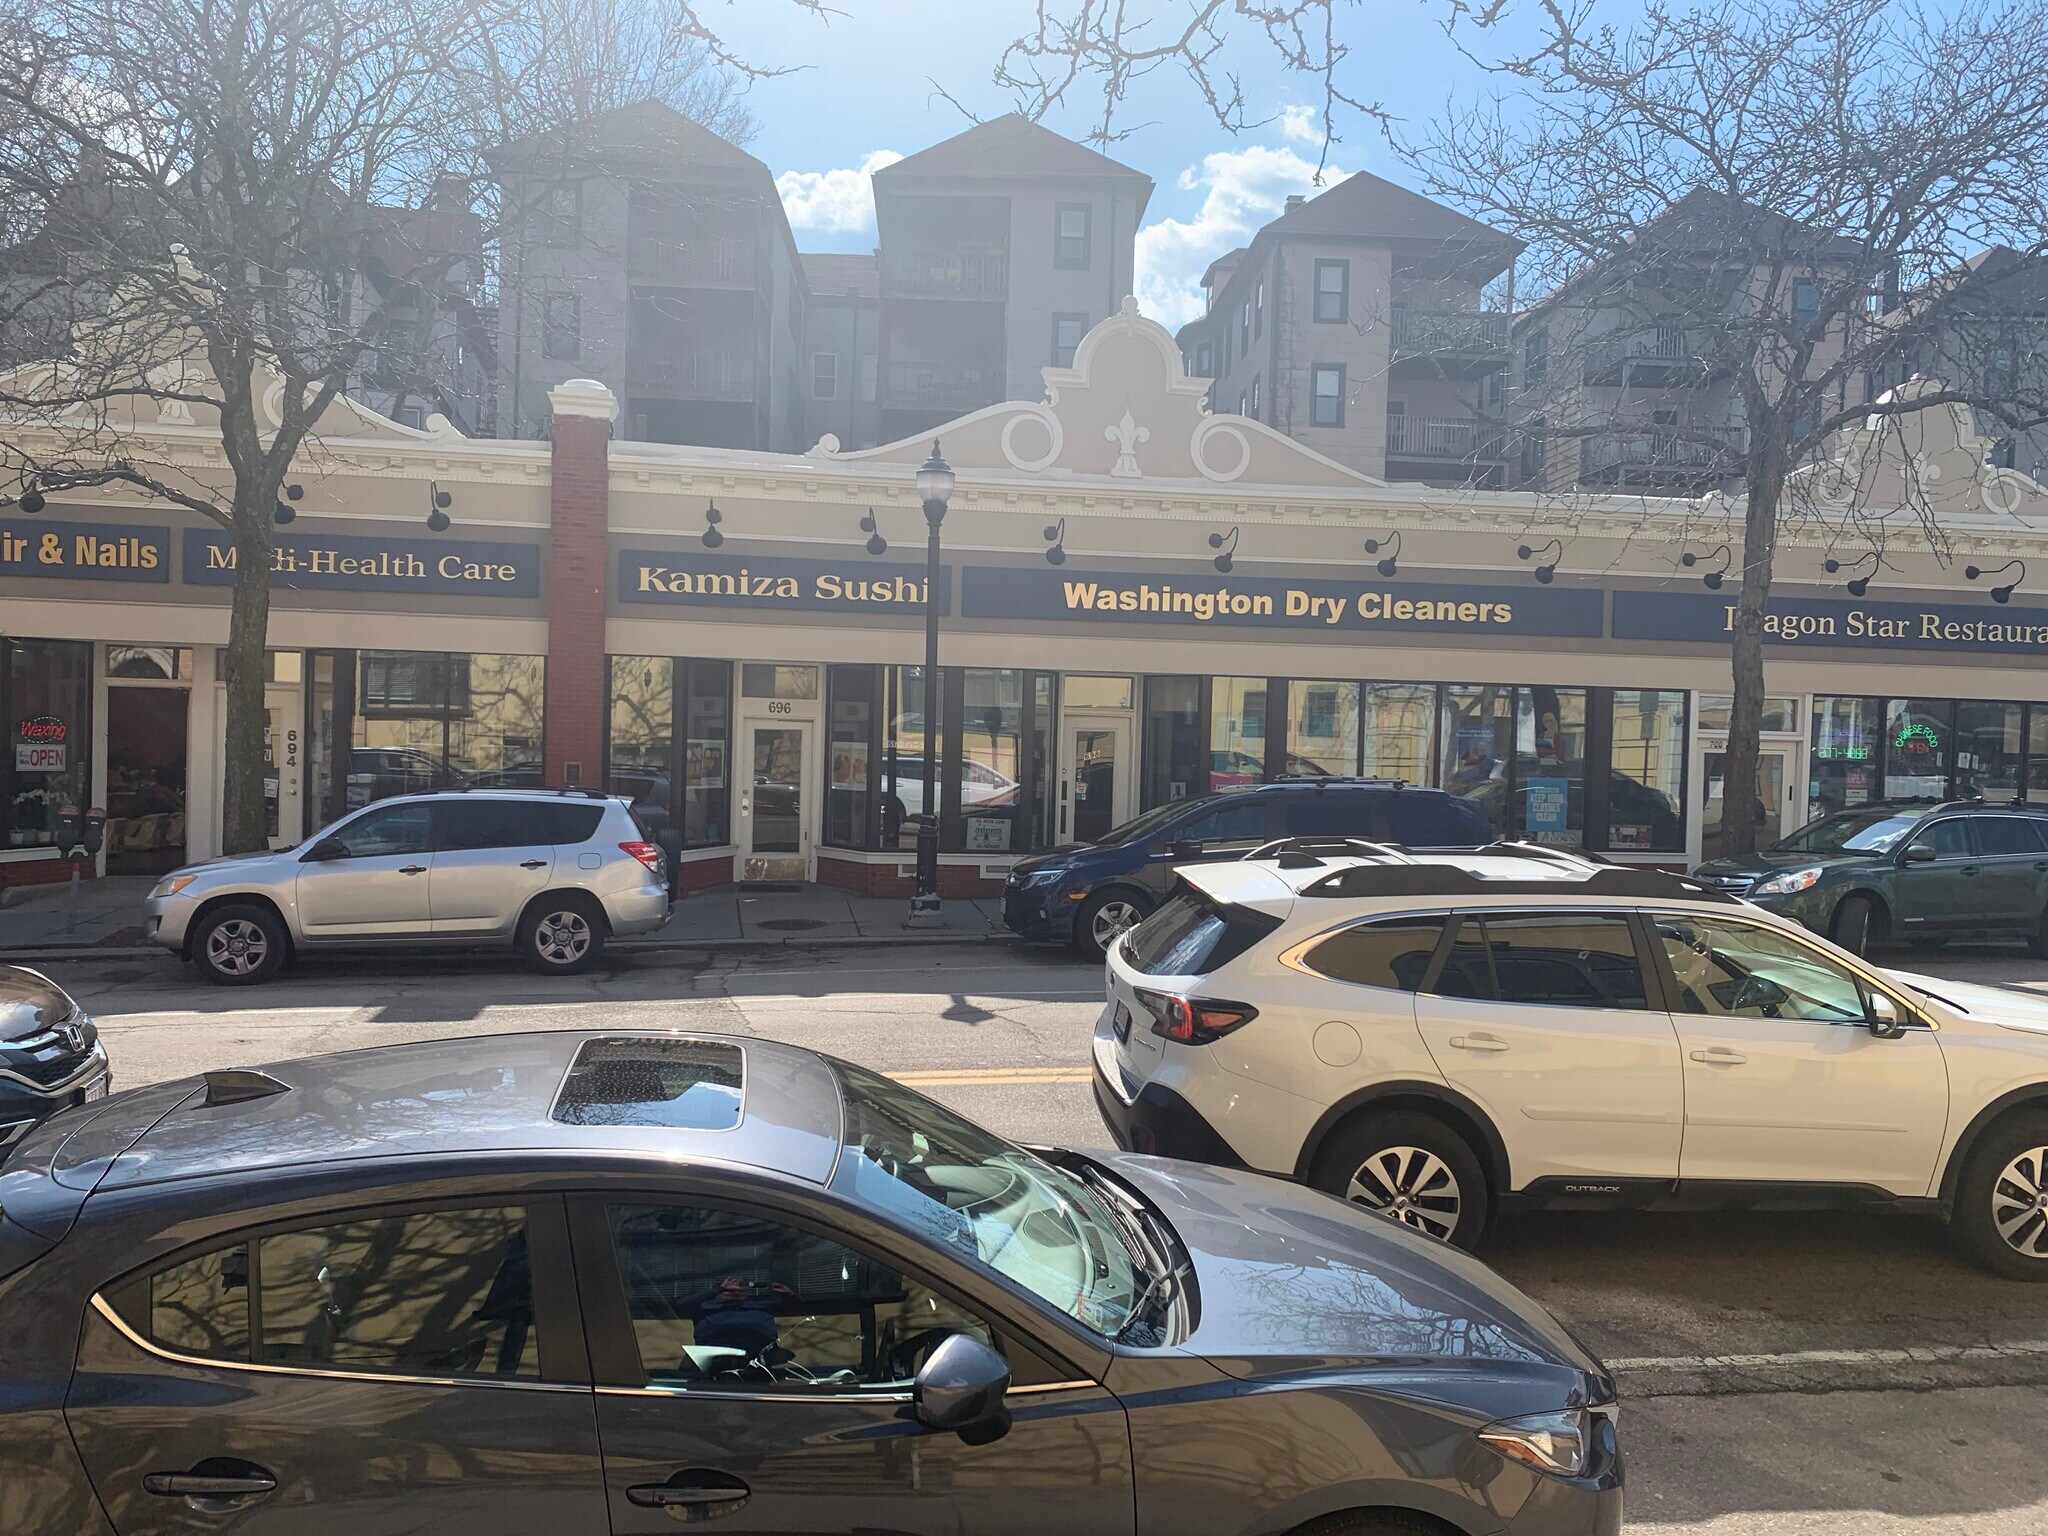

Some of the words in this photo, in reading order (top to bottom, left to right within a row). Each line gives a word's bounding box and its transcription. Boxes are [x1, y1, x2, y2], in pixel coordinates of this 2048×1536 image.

[38, 533, 64, 565] &
[75, 535, 158, 569] Nails
[206, 545, 427, 578] Mdi-Health
[438, 555, 516, 581] Care
[637, 566, 800, 599] Kamiza
[814, 573, 929, 603] Sushi
[1063, 581, 1273, 620] Washington
[1285, 590, 1347, 624] Dry
[1357, 592, 1512, 623] Cleaners
[1723, 605, 1836, 640] agon
[1846, 610, 1911, 638] Star
[1918, 613, 2048, 645] Restaura
[768, 701, 792, 714] 696
[20, 720, 67, 741] Waxing
[1895, 724, 1923, 748] CHINESE
[1922, 726, 1938, 748] FOOD
[286, 730, 298, 767] 694
[1710, 740, 1723, 749] 700
[30, 749, 64, 767] OPEN
[1084, 750, 1100, 760] 698
[1847, 773, 1866, 784] OPEN
[1532, 802, 1561, 813] CLOTHES
[1536, 812, 1557, 822] CLEAN
[1565, 1185, 1620, 1193] OUTBACK
